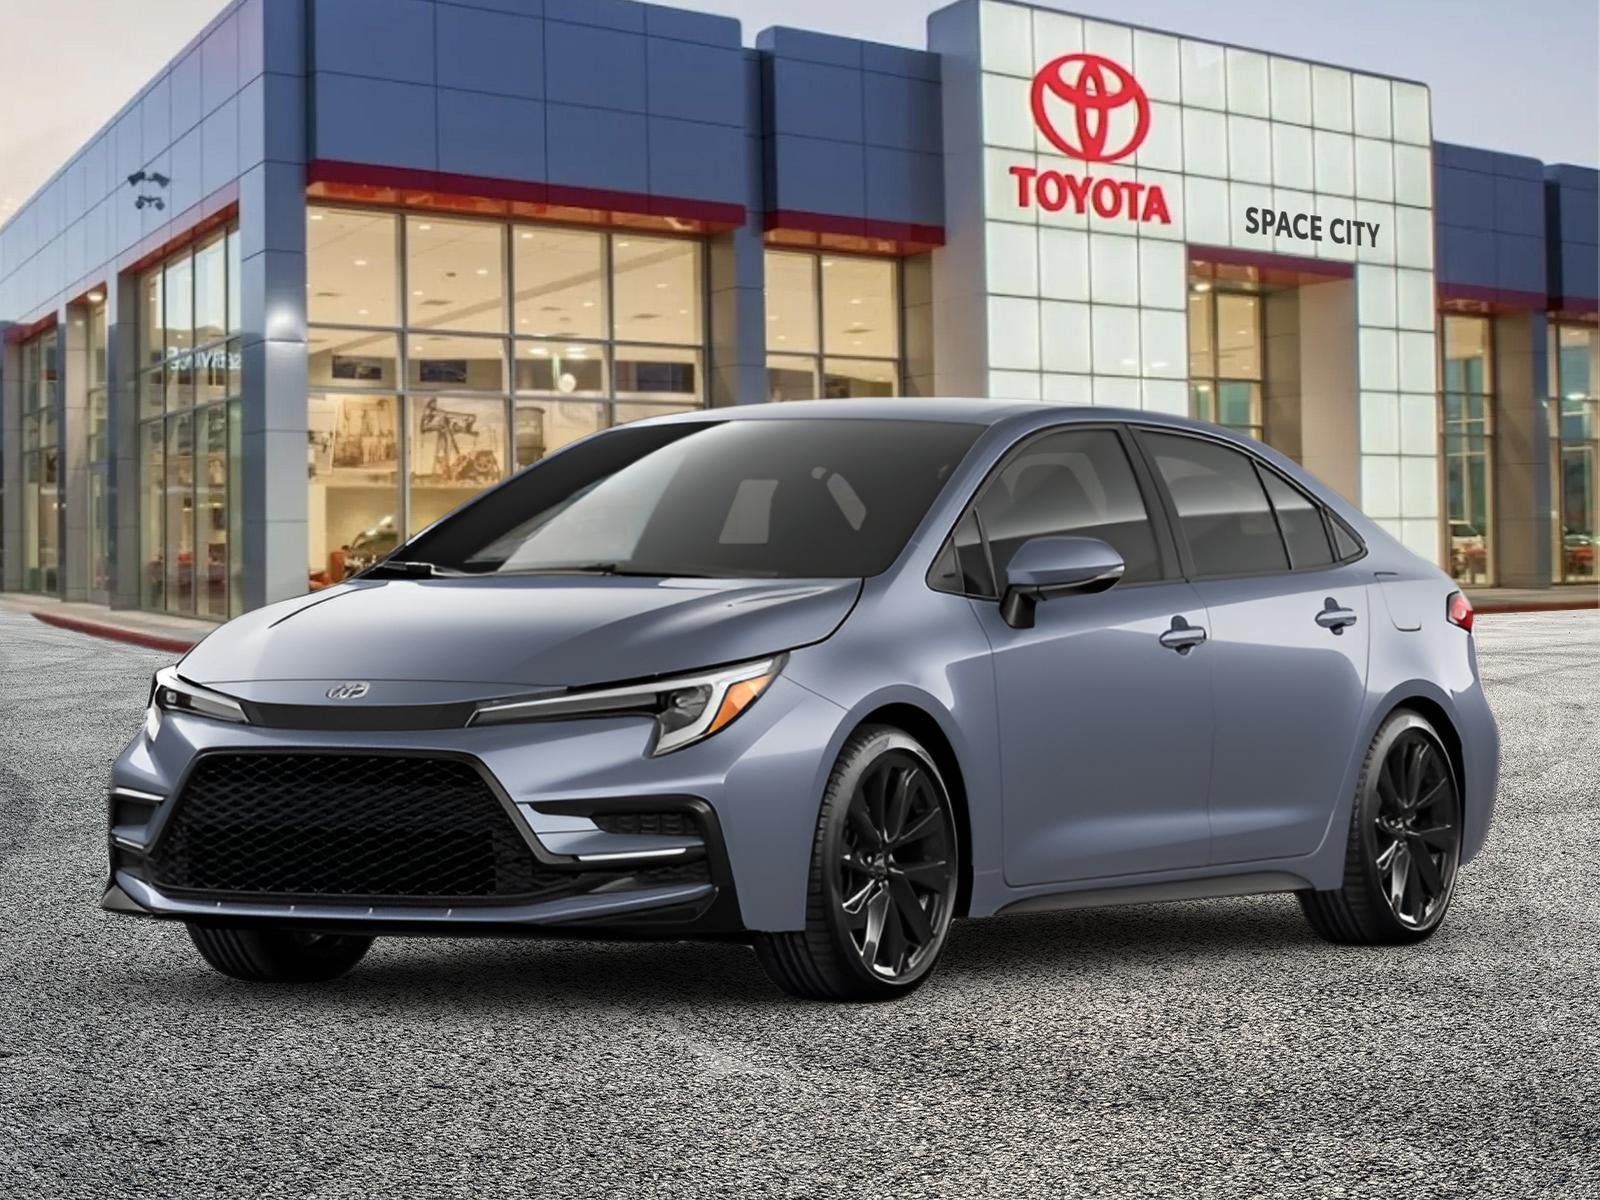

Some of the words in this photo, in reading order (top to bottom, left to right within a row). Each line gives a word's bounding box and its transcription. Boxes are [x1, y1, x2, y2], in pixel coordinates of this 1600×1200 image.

[1009, 166, 1171, 224] TOYOTA
[1245, 206, 1322, 242] SPACE
[1329, 217, 1380, 248] CITY
